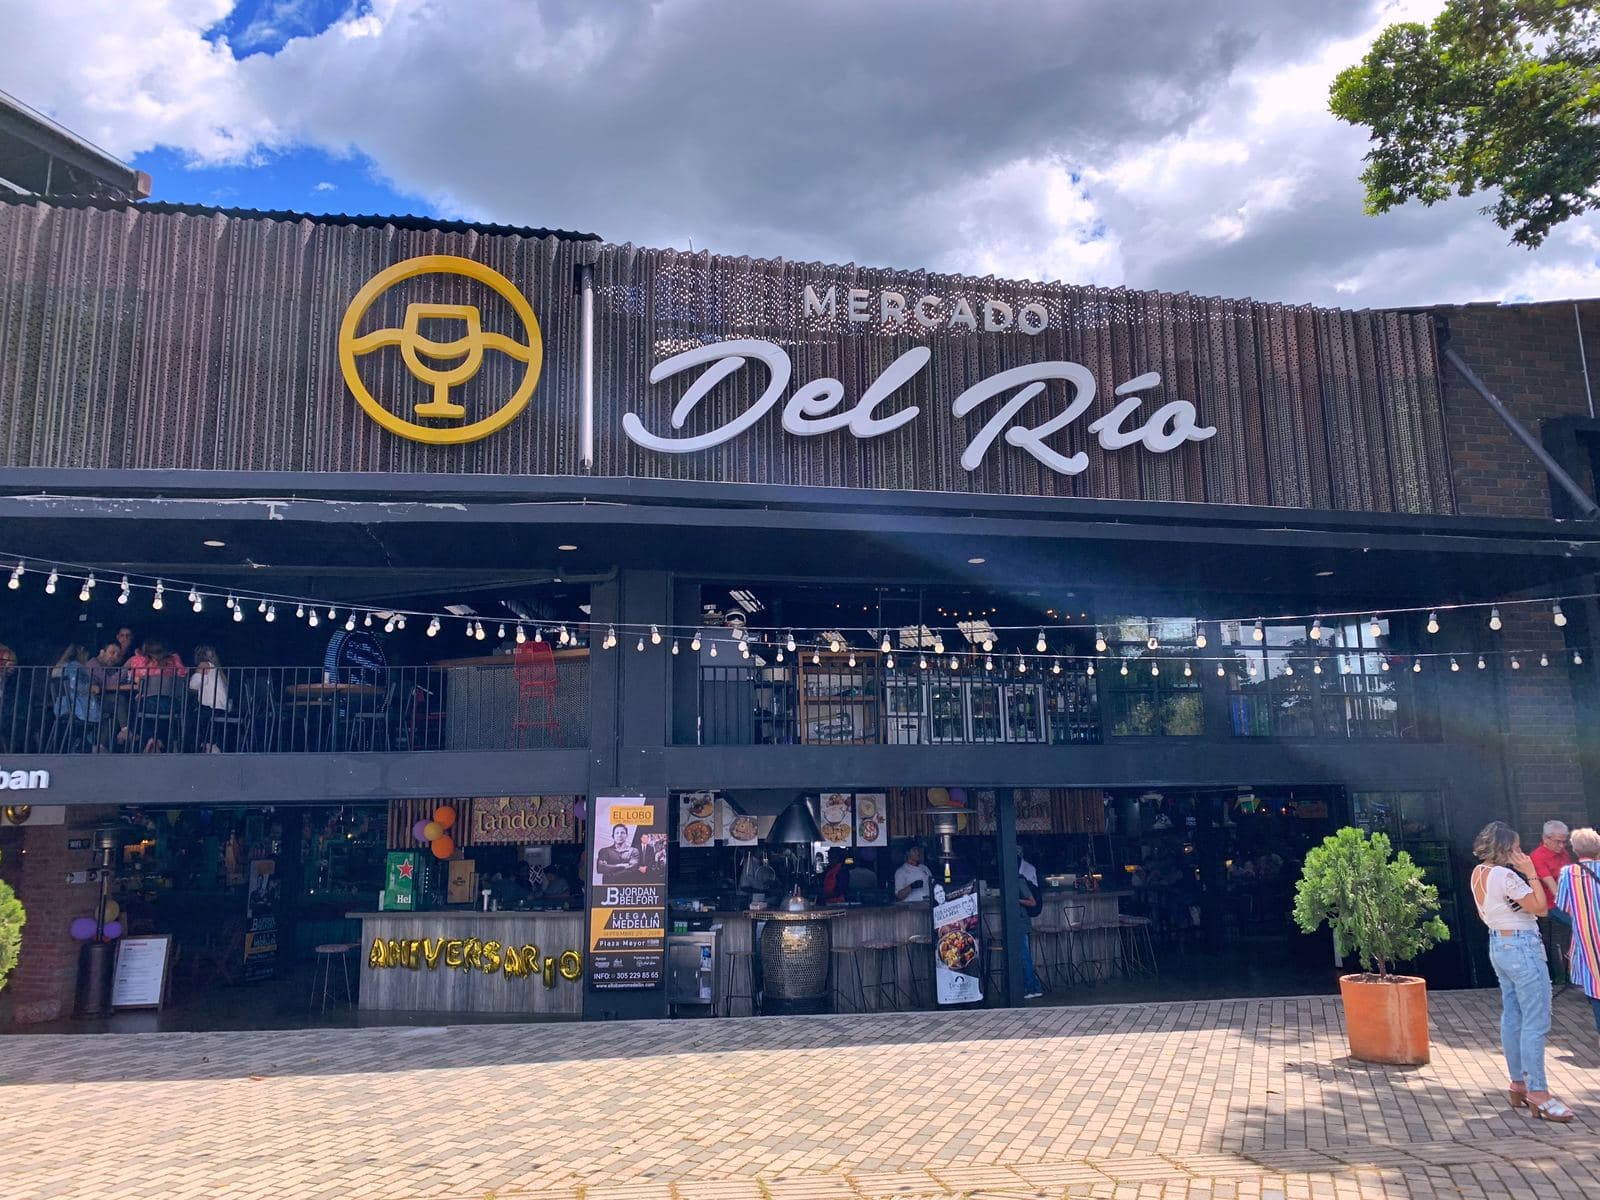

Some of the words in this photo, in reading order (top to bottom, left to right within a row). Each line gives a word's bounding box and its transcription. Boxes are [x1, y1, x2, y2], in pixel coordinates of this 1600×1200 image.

[803, 284, 1049, 336] MERCADO
[622, 339, 931, 453] Del
[952, 360, 1217, 475] Río
[613, 810, 624, 820] EL
[626, 810, 652, 820] LOBO
[474, 809, 568, 834] Tandoori
[619, 887, 656, 896] JORDAN
[619, 895, 659, 905] BELFORT
[612, 912, 647, 920] LLEGA
[653, 912, 660, 920] A
[622, 939, 646, 947] Mayor
[369, 937, 583, 990] ANIVERSARIO
[642, 971, 650, 979] 85
[651, 971, 659, 979] 65
